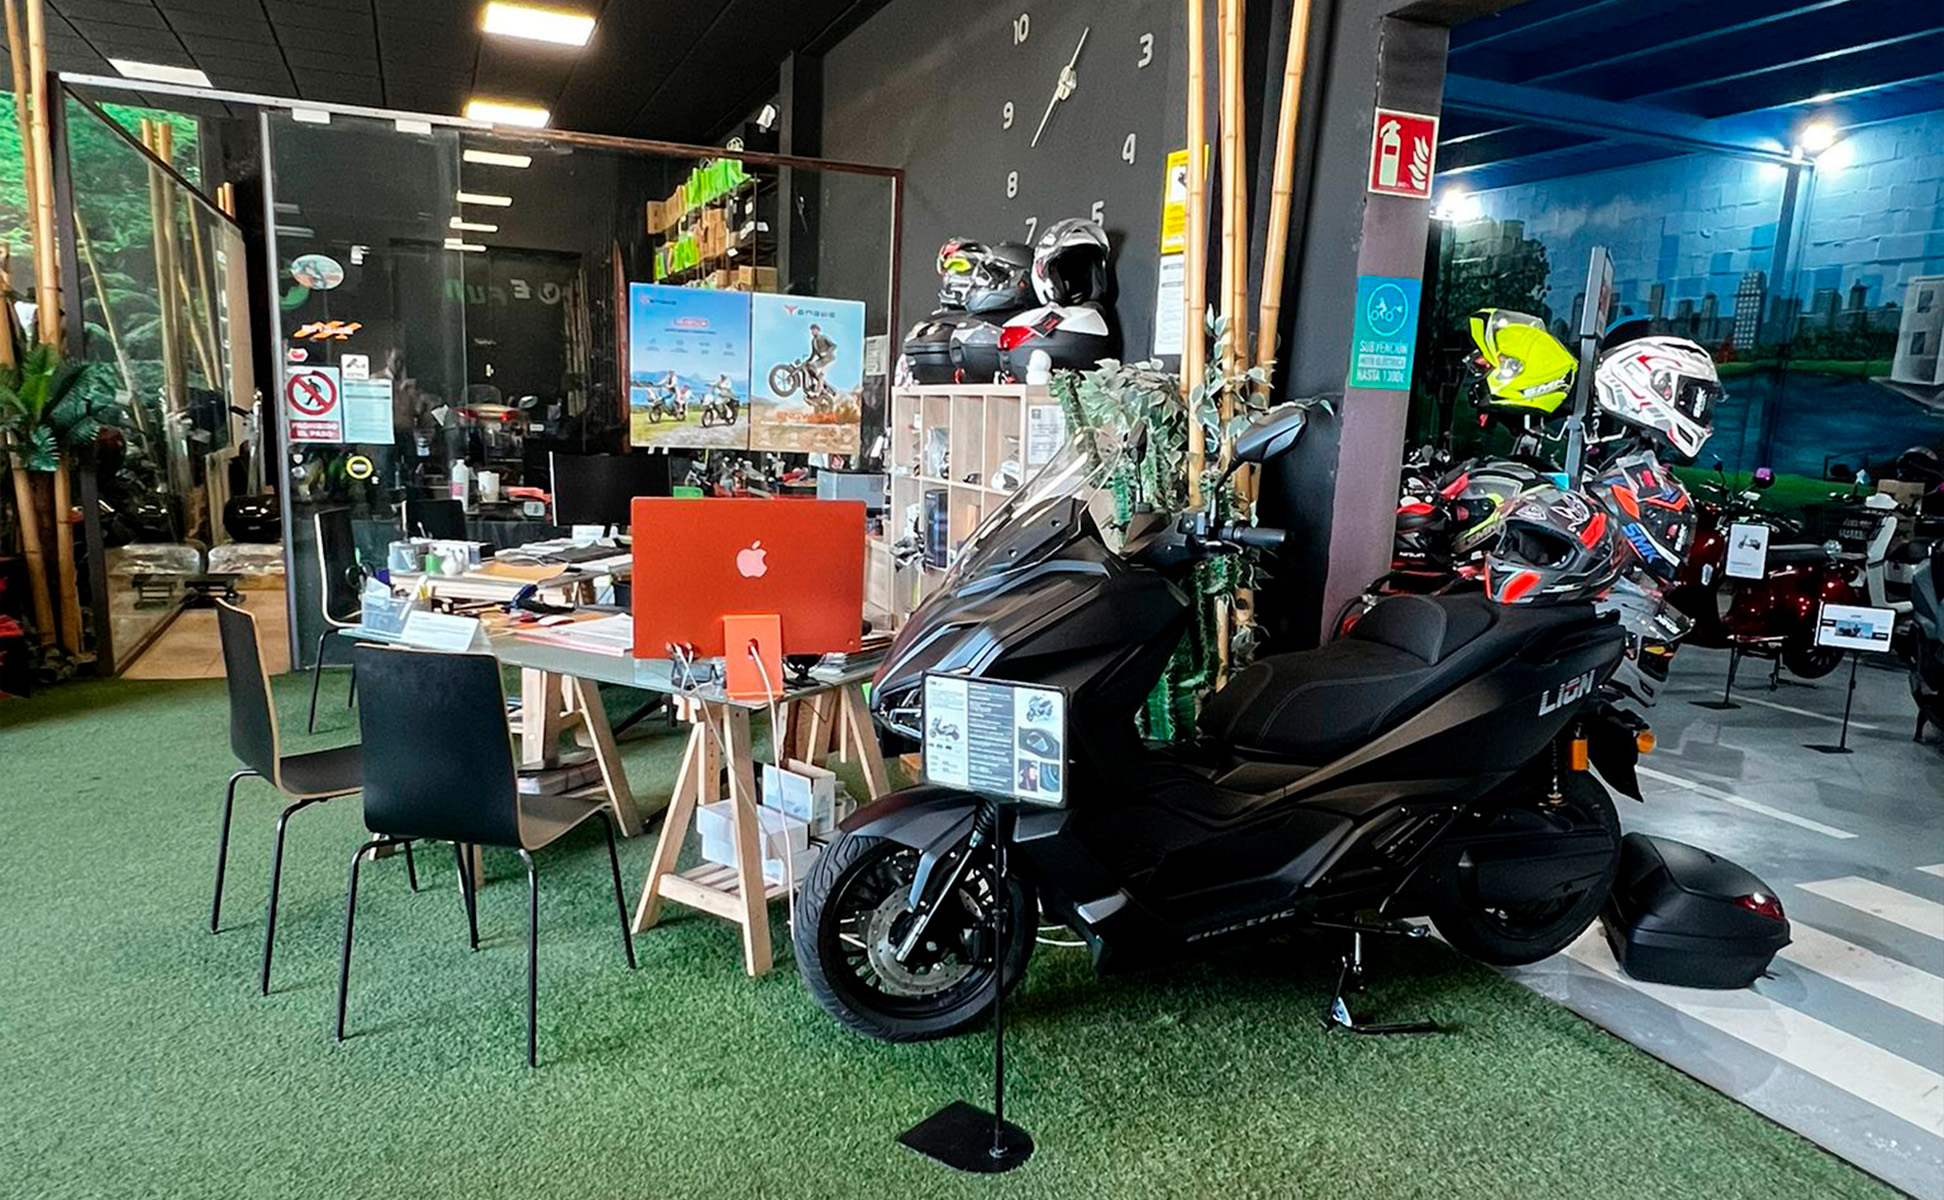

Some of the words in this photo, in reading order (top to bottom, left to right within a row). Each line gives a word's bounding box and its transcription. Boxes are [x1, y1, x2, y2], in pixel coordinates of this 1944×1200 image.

[1013, 13, 1030, 45] 10
[1138, 33, 1154, 68] 3
[1003, 101, 1014, 130] 9
[1121, 133, 1136, 165] 4
[1007, 171, 1018, 199] 8
[1092, 201, 1104, 228] 5
[1025, 217, 1037, 246] 7
[1621, 522, 1662, 564] SMK
